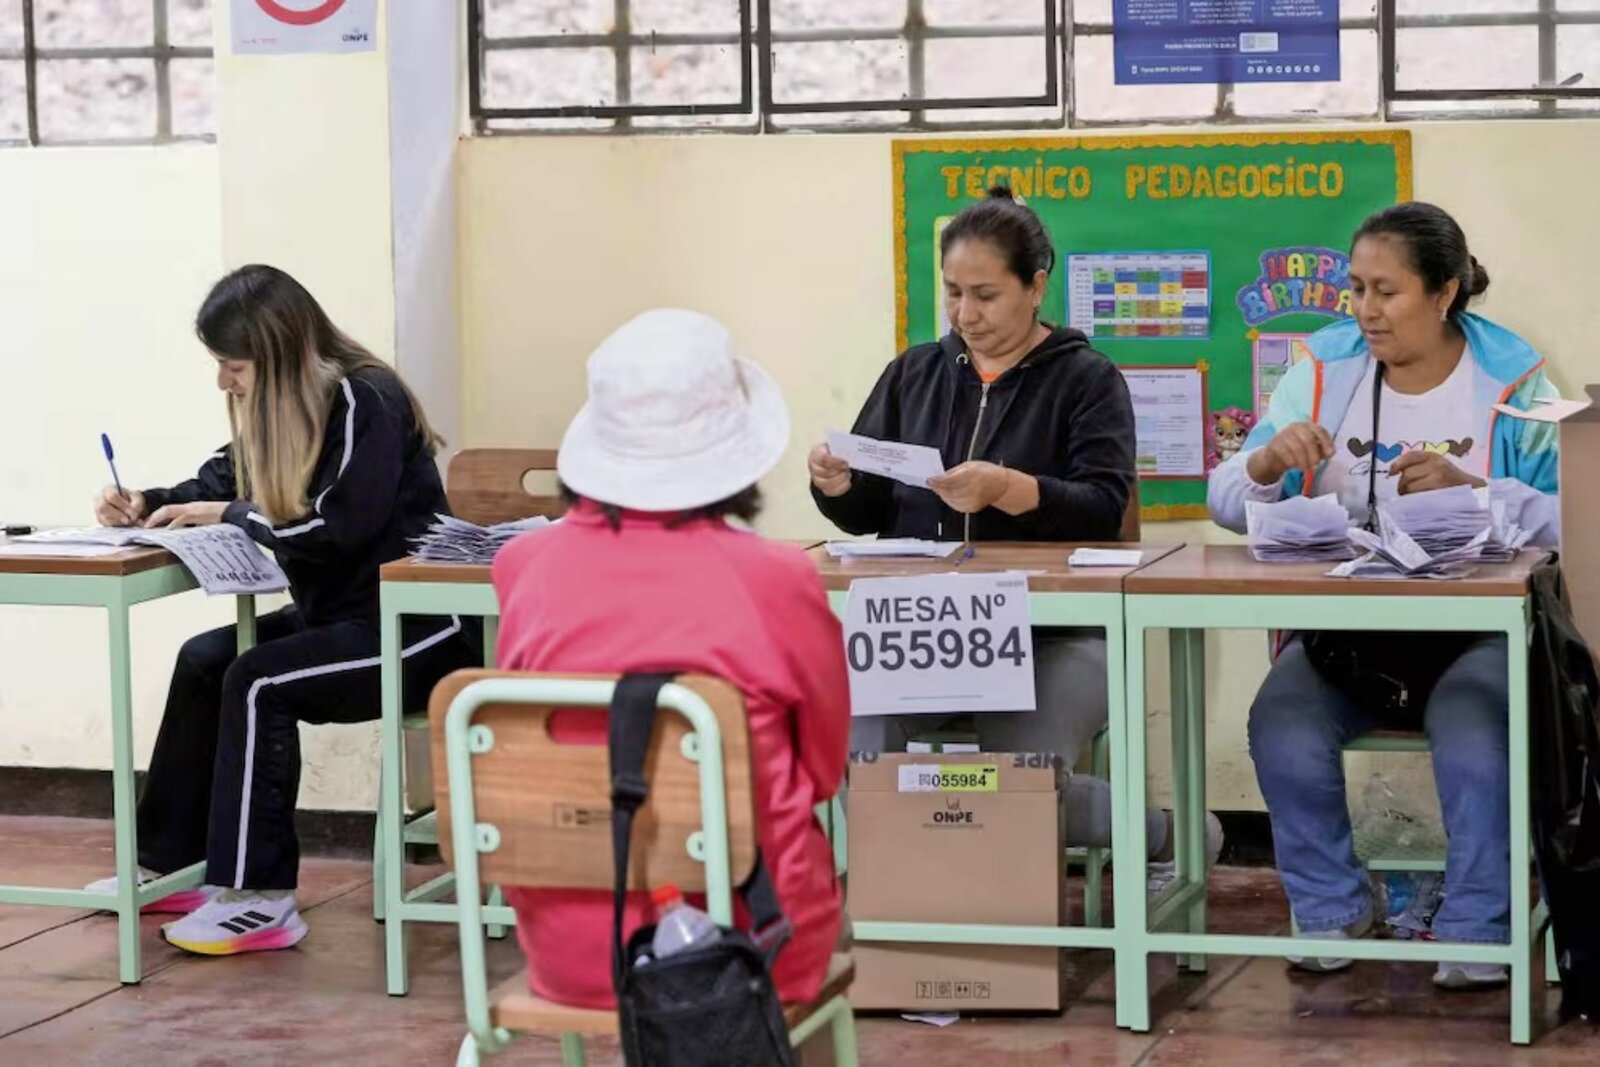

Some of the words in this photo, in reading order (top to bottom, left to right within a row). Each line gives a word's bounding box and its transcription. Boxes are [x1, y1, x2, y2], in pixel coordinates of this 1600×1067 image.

[1266, 252, 1351, 283] HAPPY
[1242, 278, 1355, 319] BIRTHDA
[865, 596, 961, 624] MESA
[848, 626, 1026, 672] 055984
[931, 774, 987, 787] 055984
[933, 808, 973, 823] ONPE
